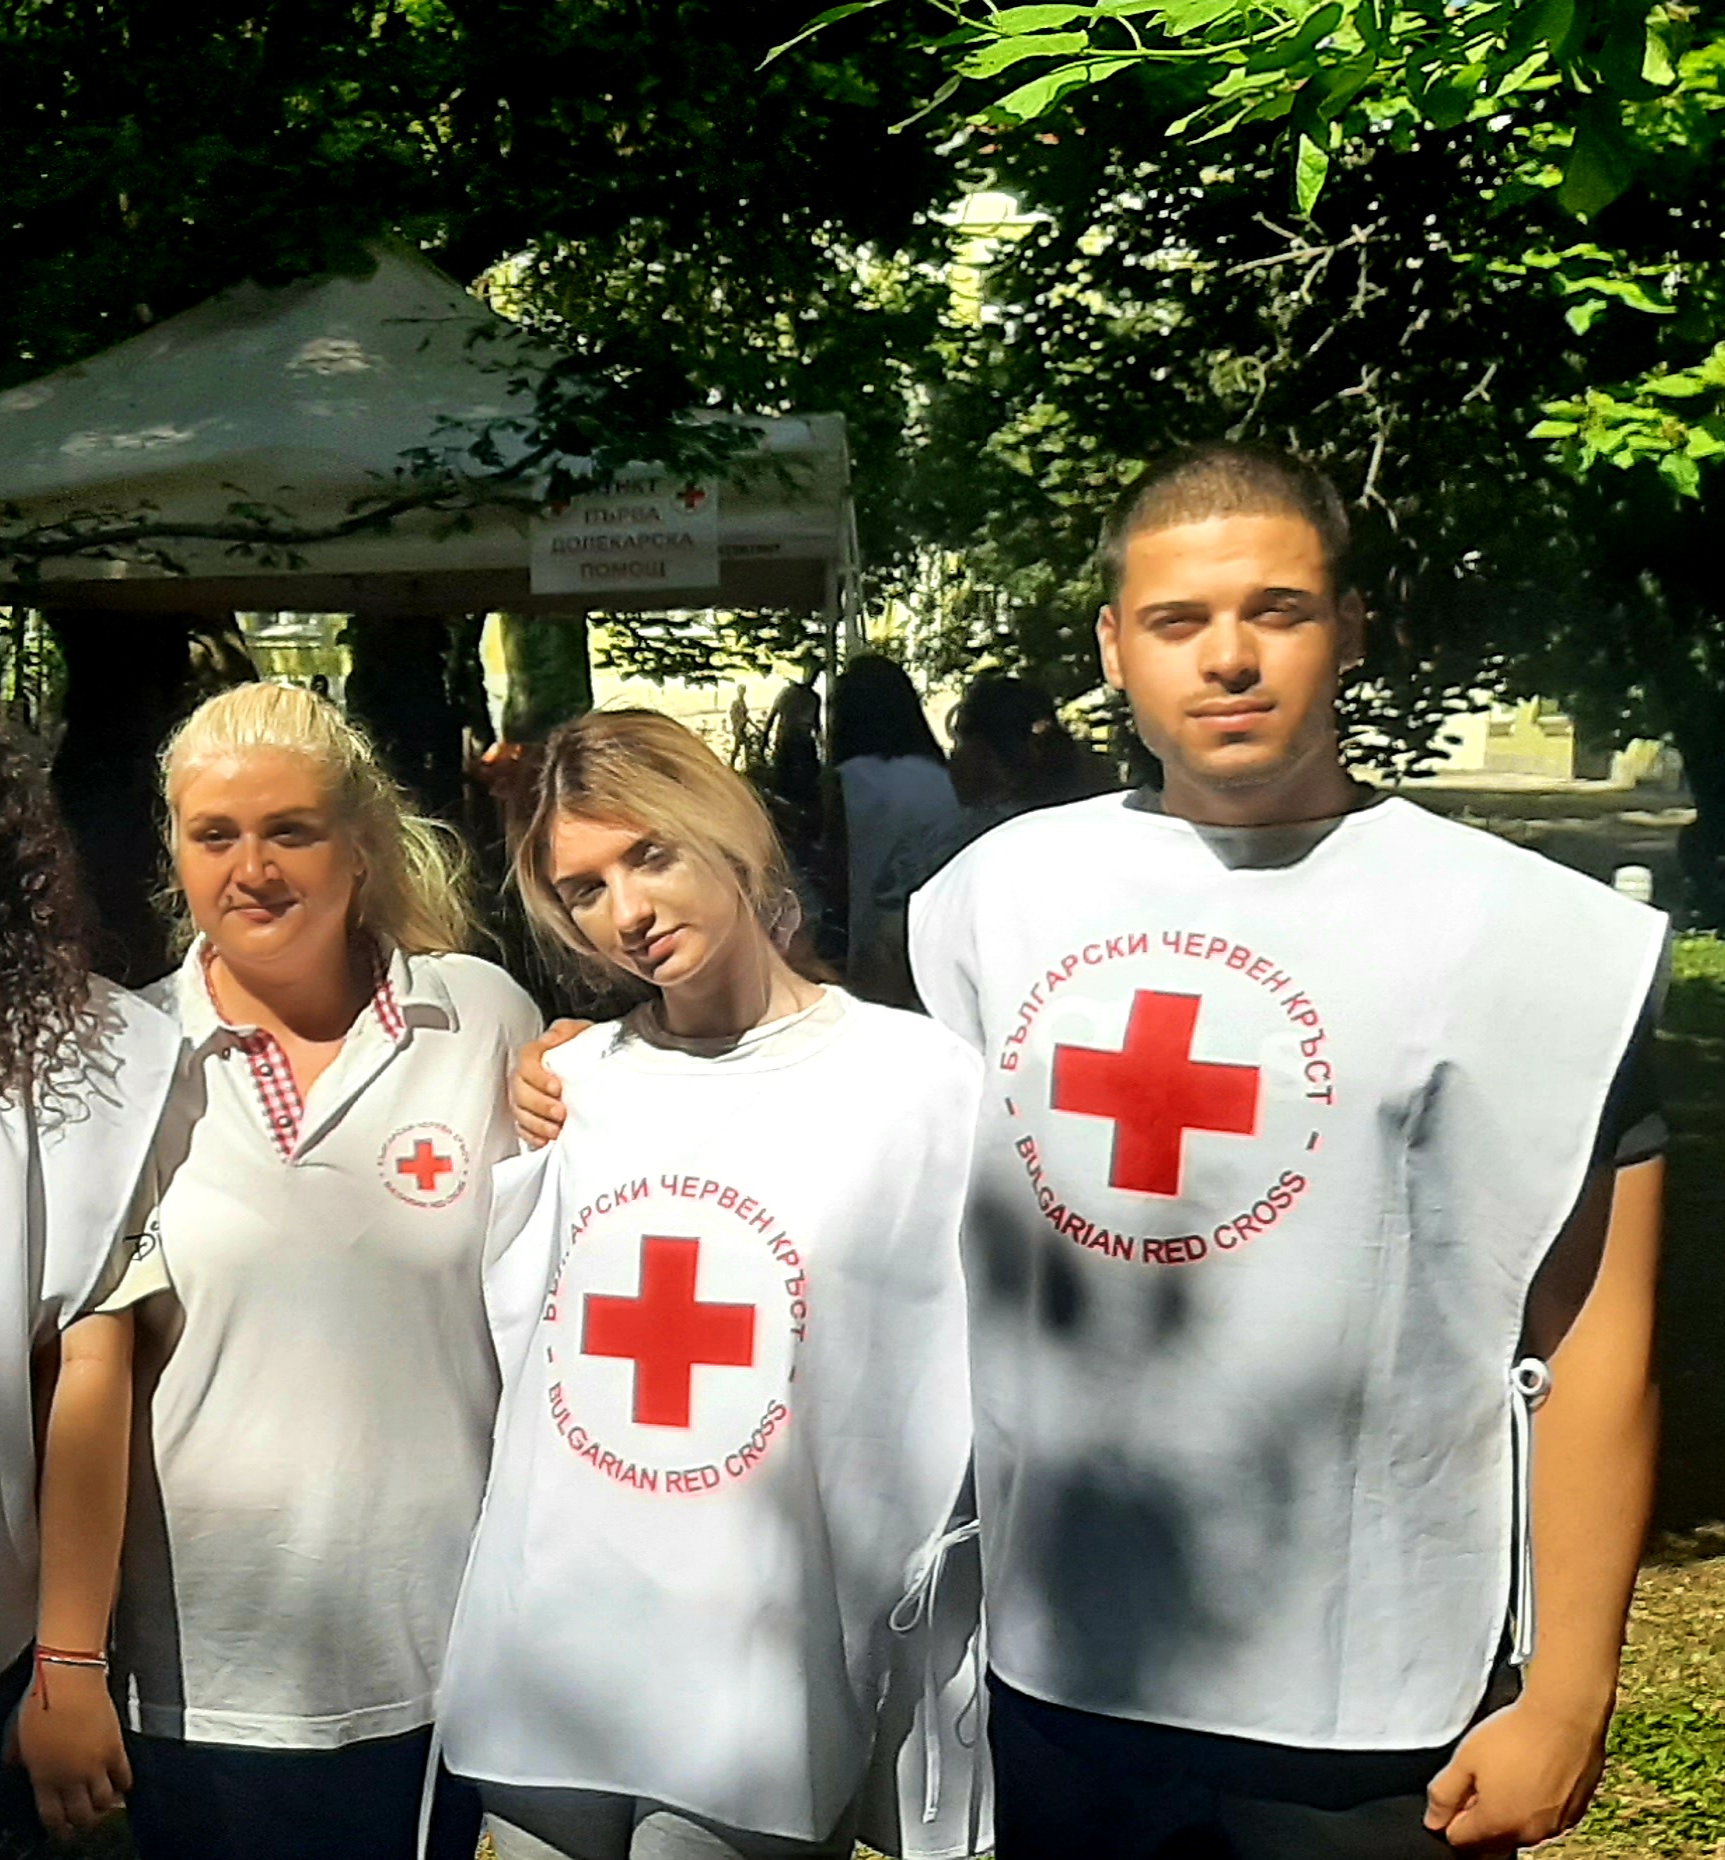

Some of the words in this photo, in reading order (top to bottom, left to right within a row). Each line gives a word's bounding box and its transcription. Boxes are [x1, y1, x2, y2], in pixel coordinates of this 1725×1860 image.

[551, 532, 694, 554] ДОЛЕКАРСКА
[580, 561, 667, 578] ПОМОЩ
[584, 506, 662, 524] ПЪРВА
[1000, 933, 1149, 1072] БЪЛГАРСКИ
[1162, 930, 1292, 993] ЧЕРВЕН
[1281, 991, 1334, 1105] КРЪСТ
[1014, 1135, 1135, 1261] BULGARIAN
[1142, 1234, 1207, 1265] RED
[1213, 1169, 1306, 1250] CROSS
[661, 1174, 774, 1234] ЧЕРВЕН
[767, 1231, 807, 1342] КРЪСТ
[548, 1381, 658, 1491] BULGARIAN
[665, 1465, 721, 1492] RED
[725, 1399, 787, 1478] CROSS
